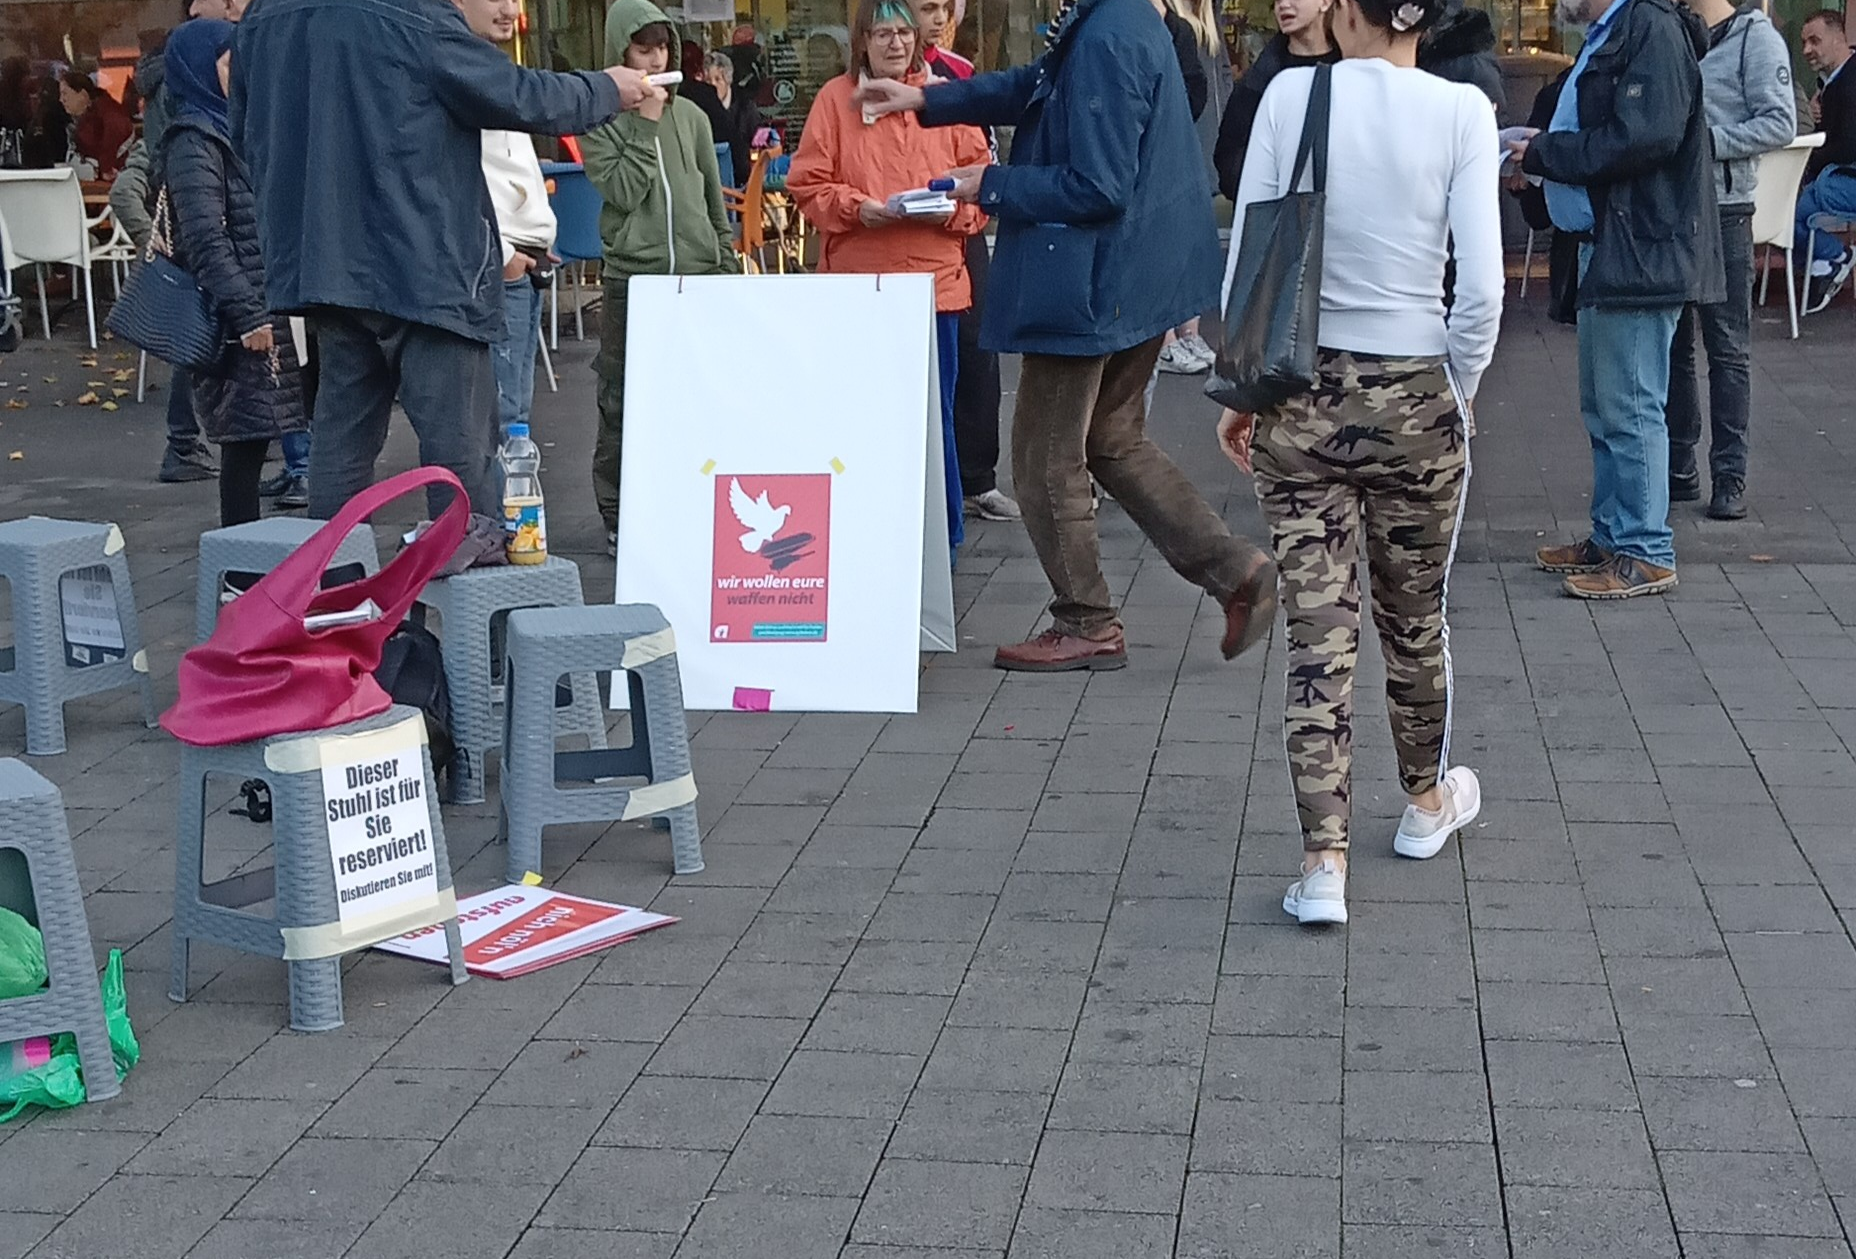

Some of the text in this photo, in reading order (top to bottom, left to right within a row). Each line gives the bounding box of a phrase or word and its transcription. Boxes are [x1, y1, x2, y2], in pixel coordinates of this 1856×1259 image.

[717, 574, 824, 589] wir wollen eure
[727, 591, 815, 605] waffen nicht
[345, 758, 398, 789] Dieser
[328, 777, 420, 822] Stuhl ist für
[365, 814, 392, 839] Sie
[339, 828, 427, 875] reserviert!
[340, 862, 433, 903] Diskutieren Sie mit!
